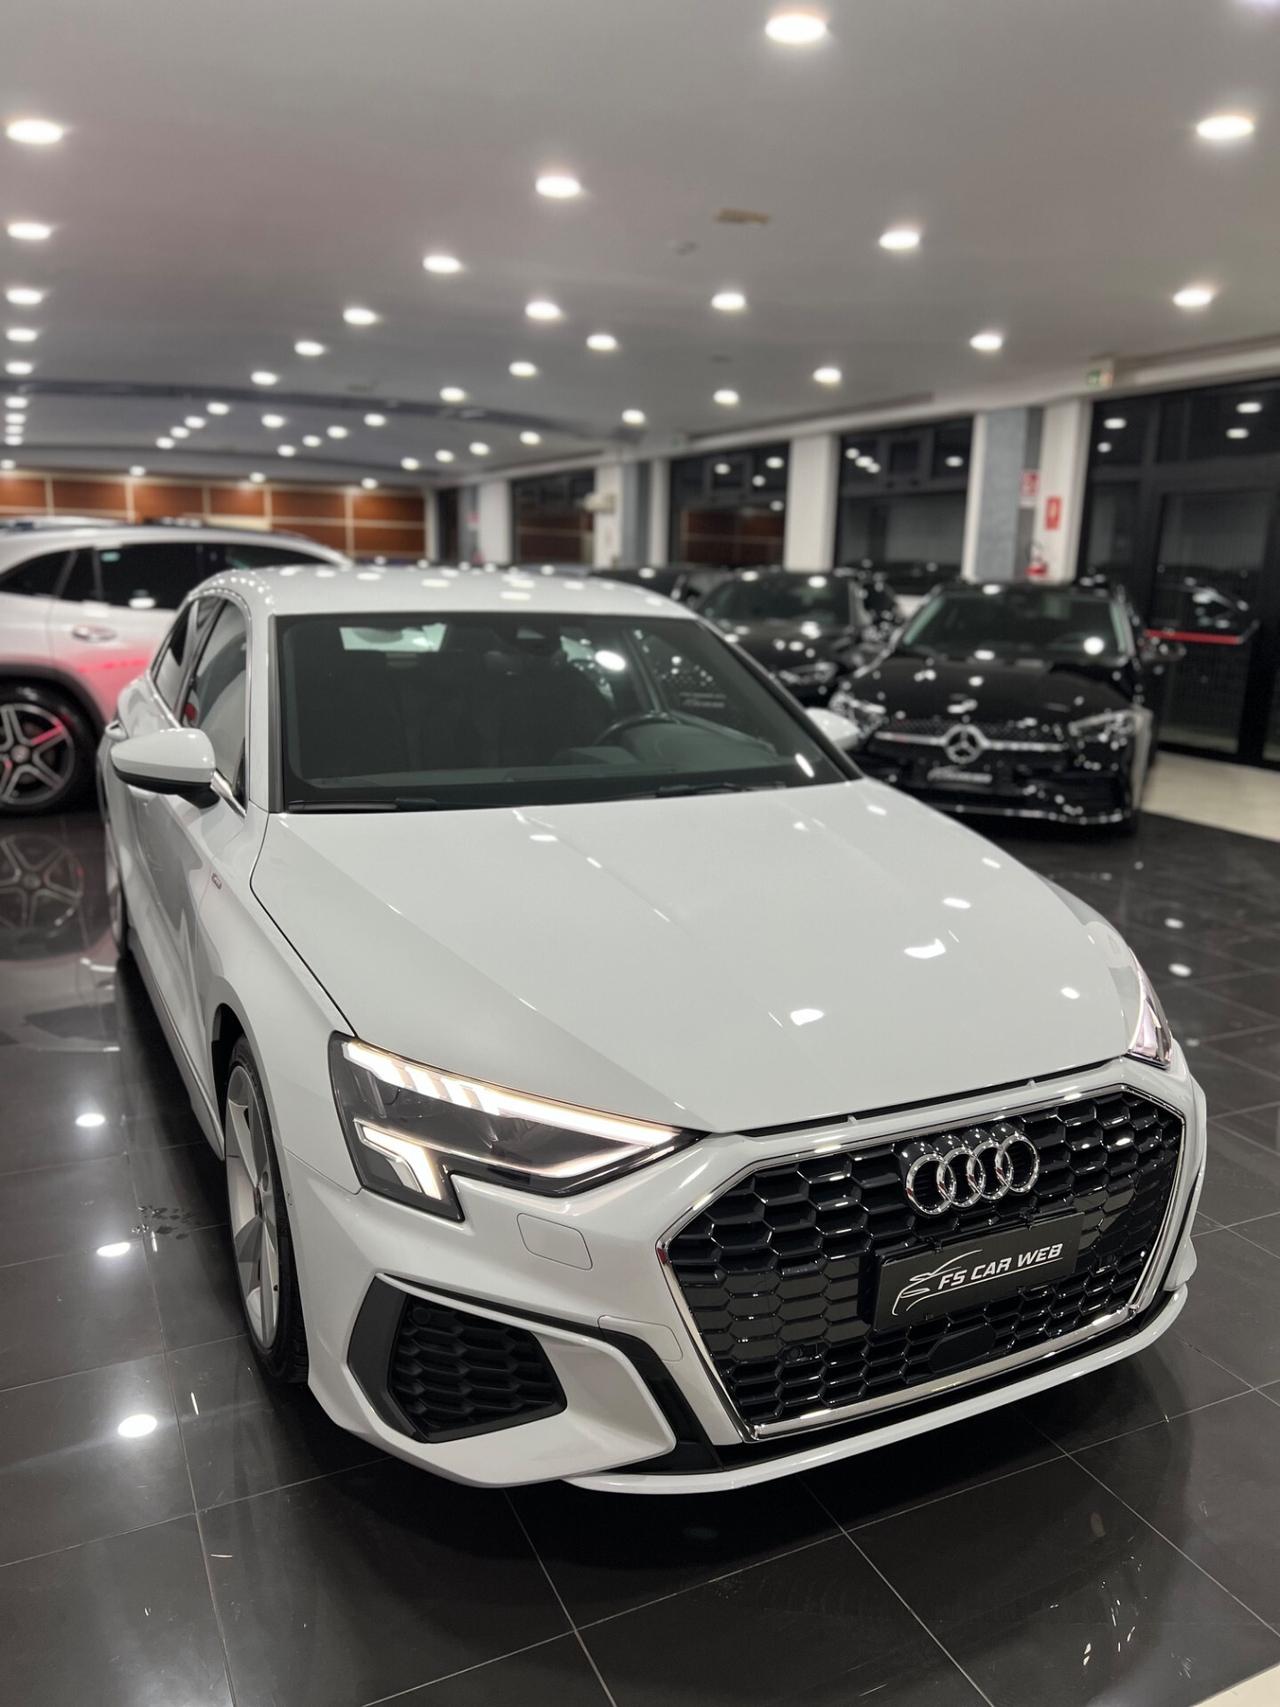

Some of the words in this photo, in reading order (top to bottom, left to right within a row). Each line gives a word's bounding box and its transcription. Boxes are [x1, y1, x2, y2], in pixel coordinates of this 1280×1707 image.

[938, 1270, 967, 1290] FS
[970, 1257, 1011, 1281] CAR
[1017, 1243, 1063, 1267] WEB
